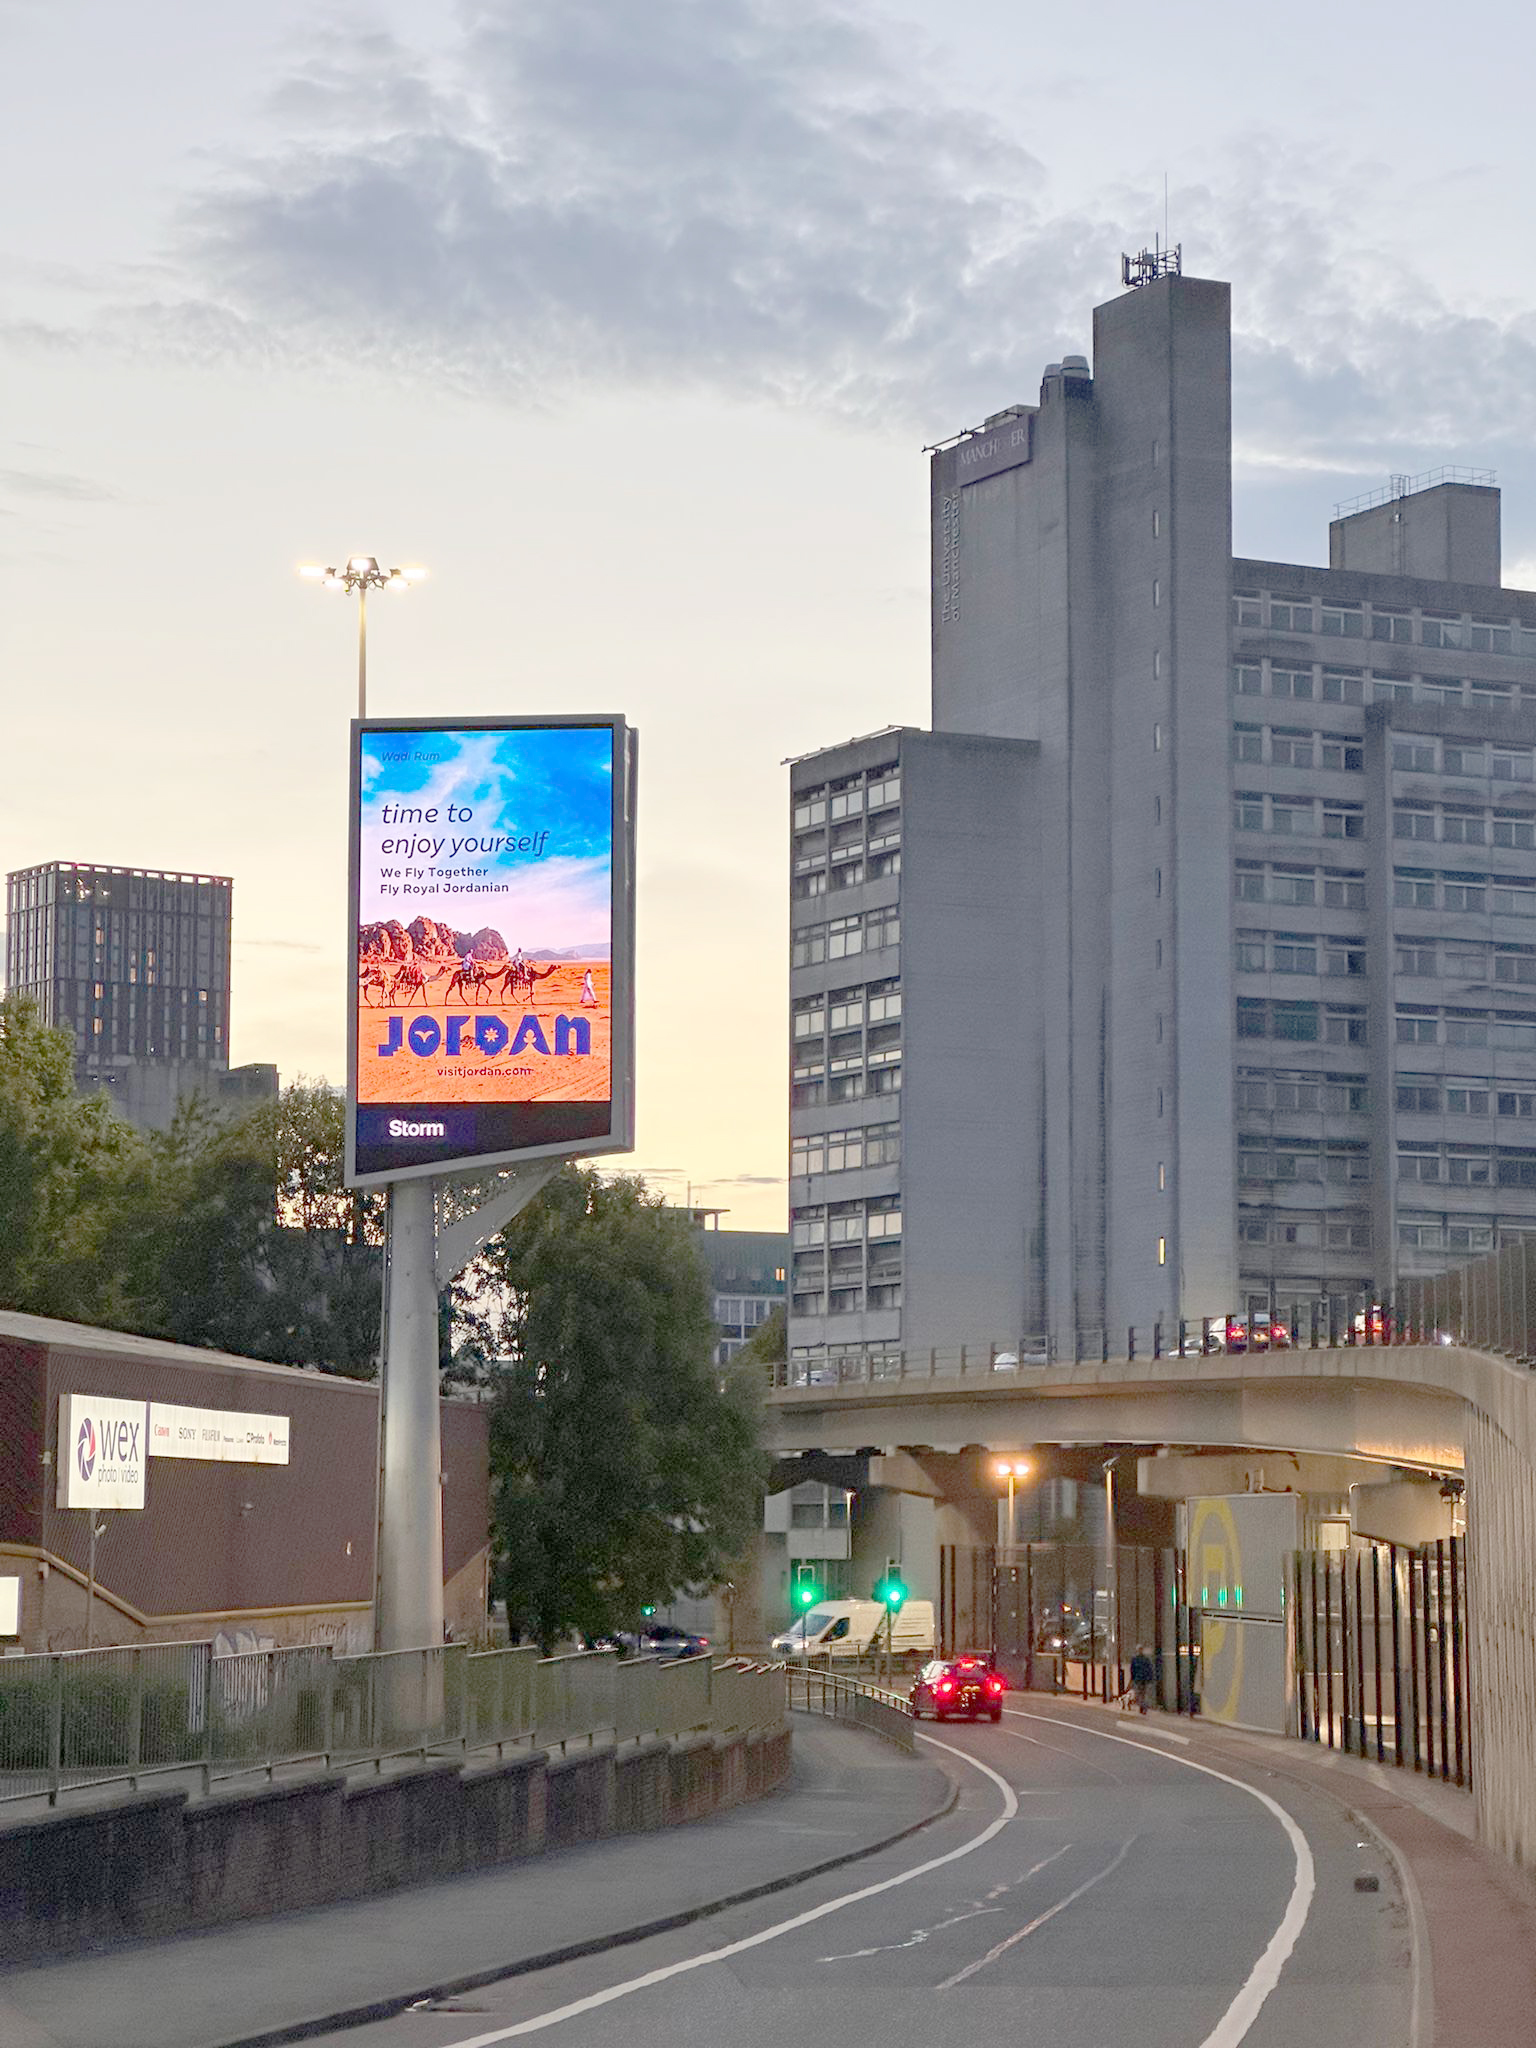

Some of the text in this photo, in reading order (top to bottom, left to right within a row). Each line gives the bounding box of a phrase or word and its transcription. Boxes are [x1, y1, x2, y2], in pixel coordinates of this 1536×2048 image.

[941, 496, 952, 624] The University
[950, 491, 960, 622] of Manchester
[381, 751, 441, 762] Wadi Rum
[381, 803, 473, 824] time to
[381, 831, 549, 859] enjoy yourself
[380, 866, 488, 880] We Fly Together
[380, 882, 509, 896] Fly Royal Jordanian
[437, 1066, 534, 1079] visitjordan.com
[388, 1119, 444, 1137] Storm
[100, 1419, 139, 1462] wex
[178, 1426, 197, 1440] SONY
[97, 1464, 139, 1487] photo video
